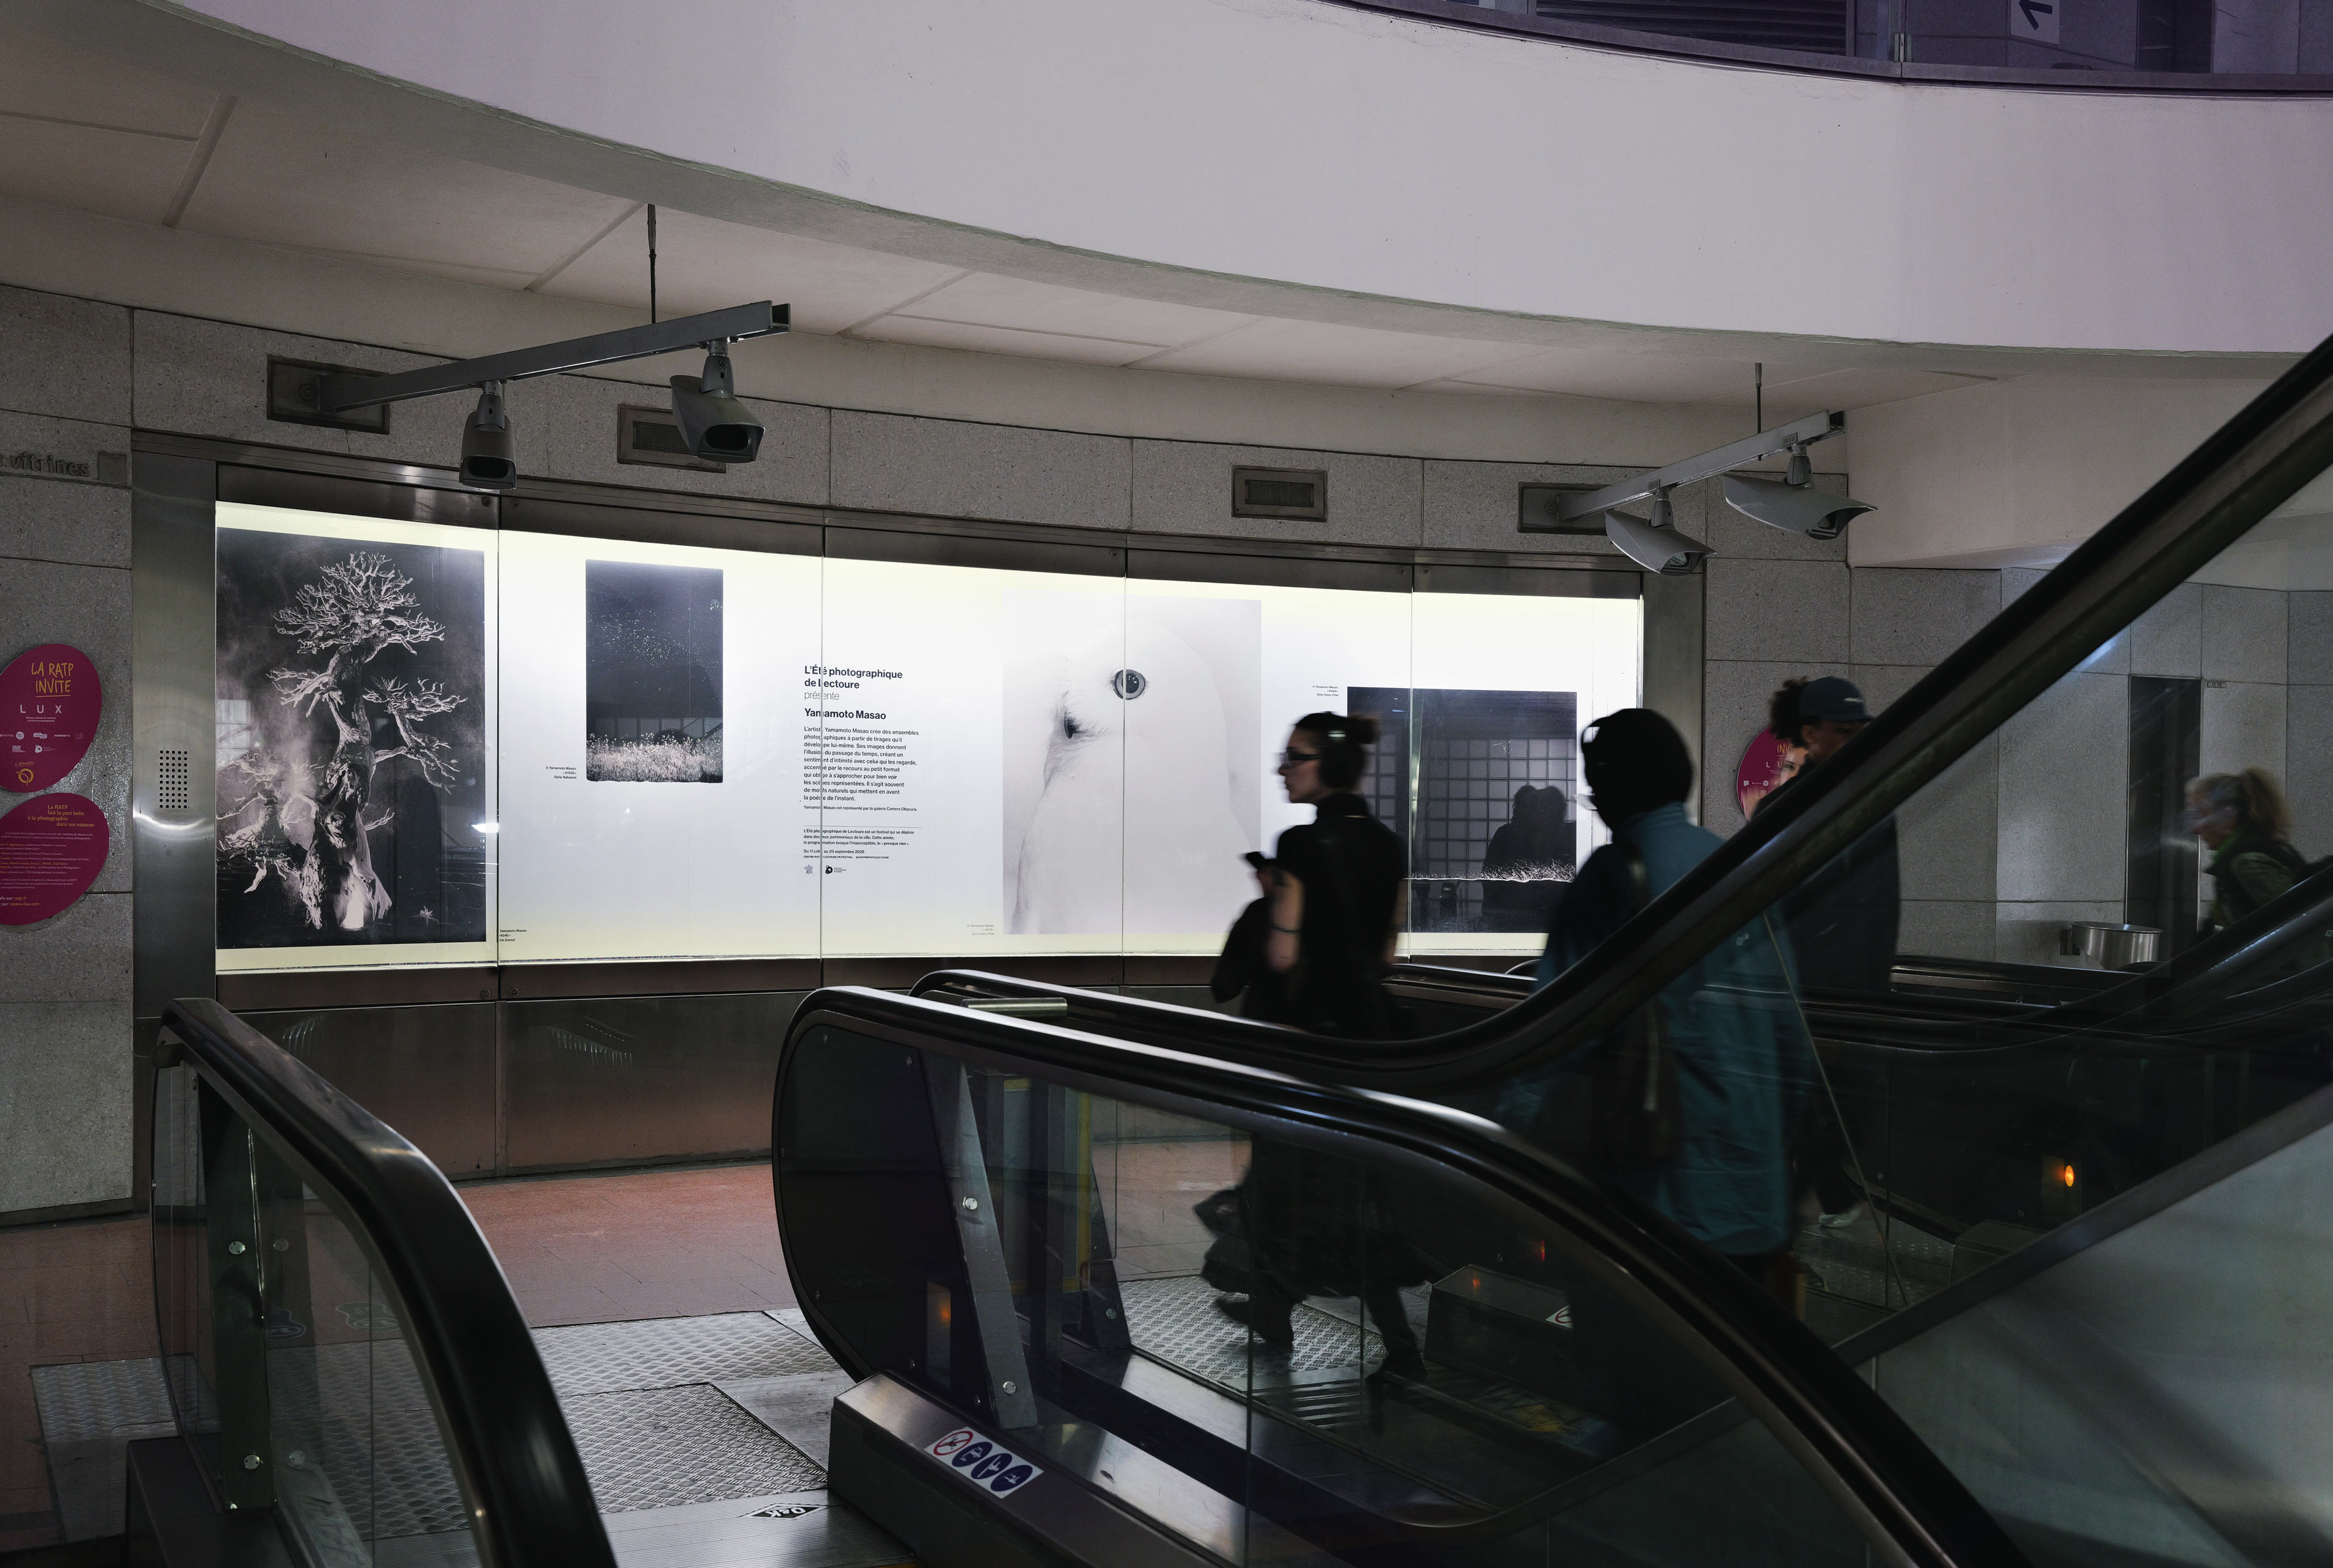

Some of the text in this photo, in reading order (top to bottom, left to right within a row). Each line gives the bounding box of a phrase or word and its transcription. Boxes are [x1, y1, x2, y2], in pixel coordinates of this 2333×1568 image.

[10, 452, 89, 477] vitrines
[32, 662, 73, 678] LA RATP
[829, 667, 903, 679] photographique
[36, 678, 71, 693] INVITE
[805, 678, 816, 687] de
[856, 710, 886, 719] Masao
[764, 1507, 806, 1517] O&K
